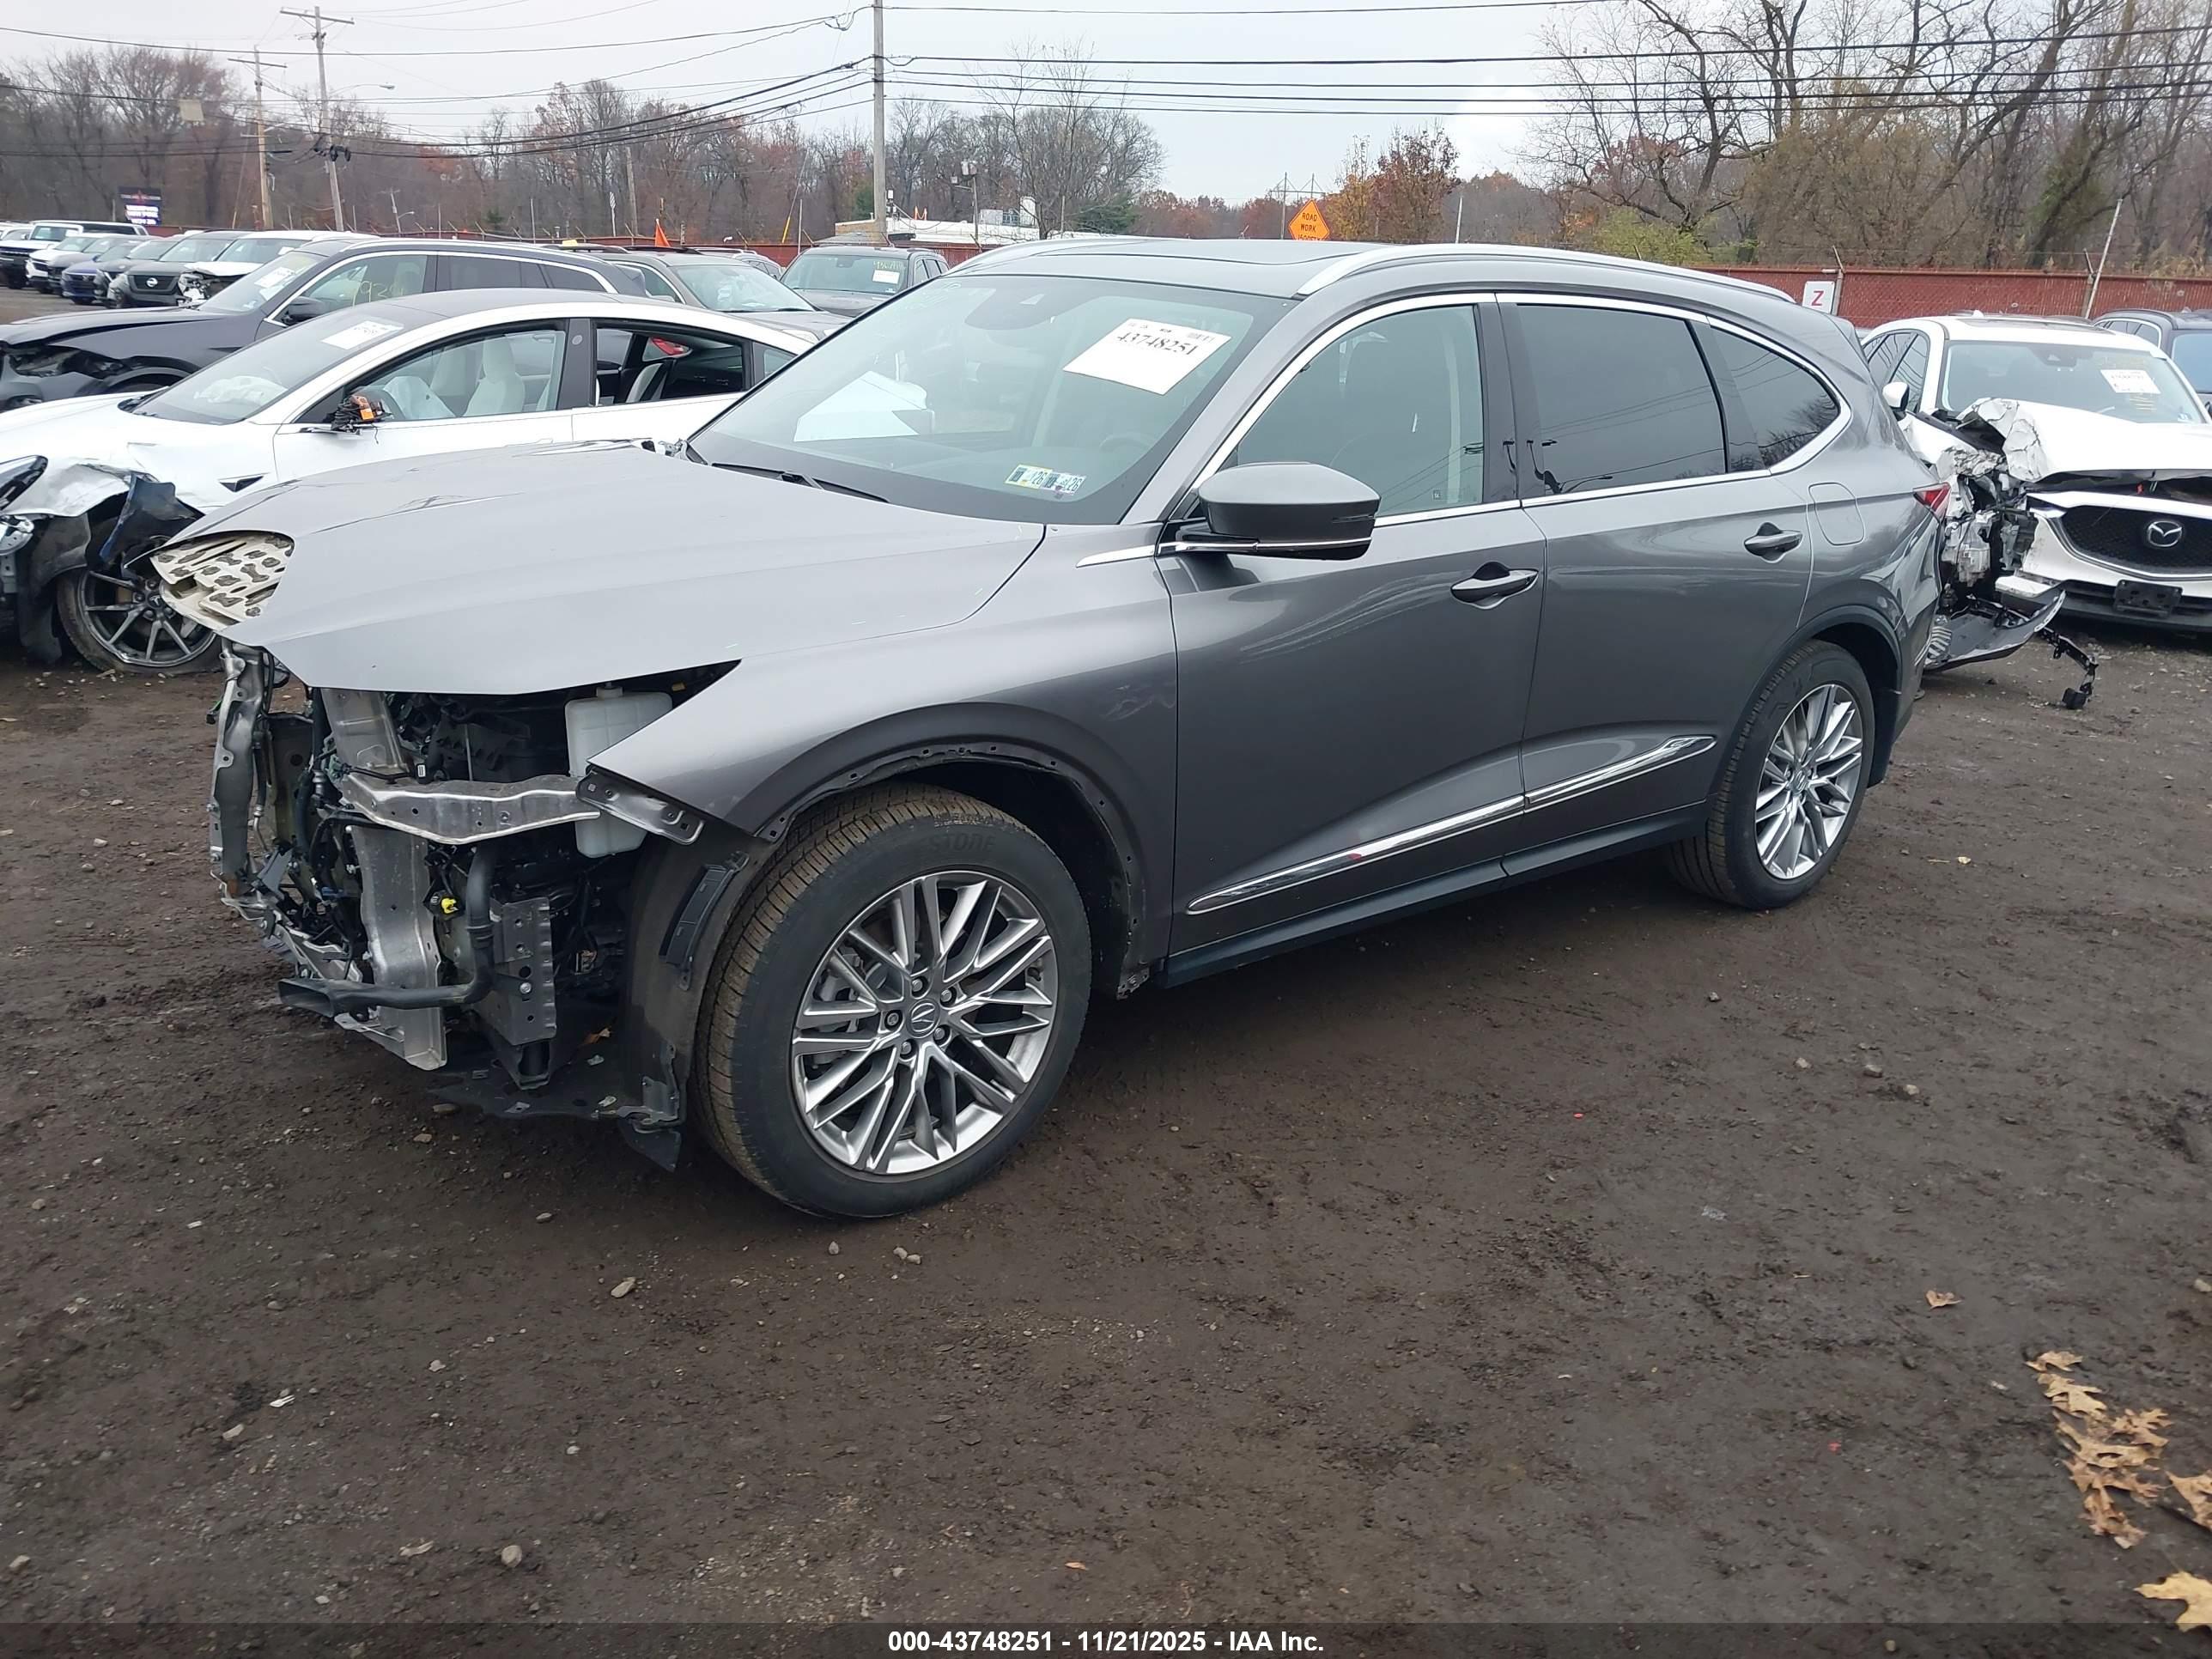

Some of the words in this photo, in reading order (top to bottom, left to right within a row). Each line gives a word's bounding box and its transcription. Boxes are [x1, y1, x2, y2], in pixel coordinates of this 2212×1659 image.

[1302, 212, 1317, 222] ROAD
[1300, 223, 1316, 232] WORK
[1812, 290, 1824, 306] Z
[1117, 331, 1199, 356] 43748251
